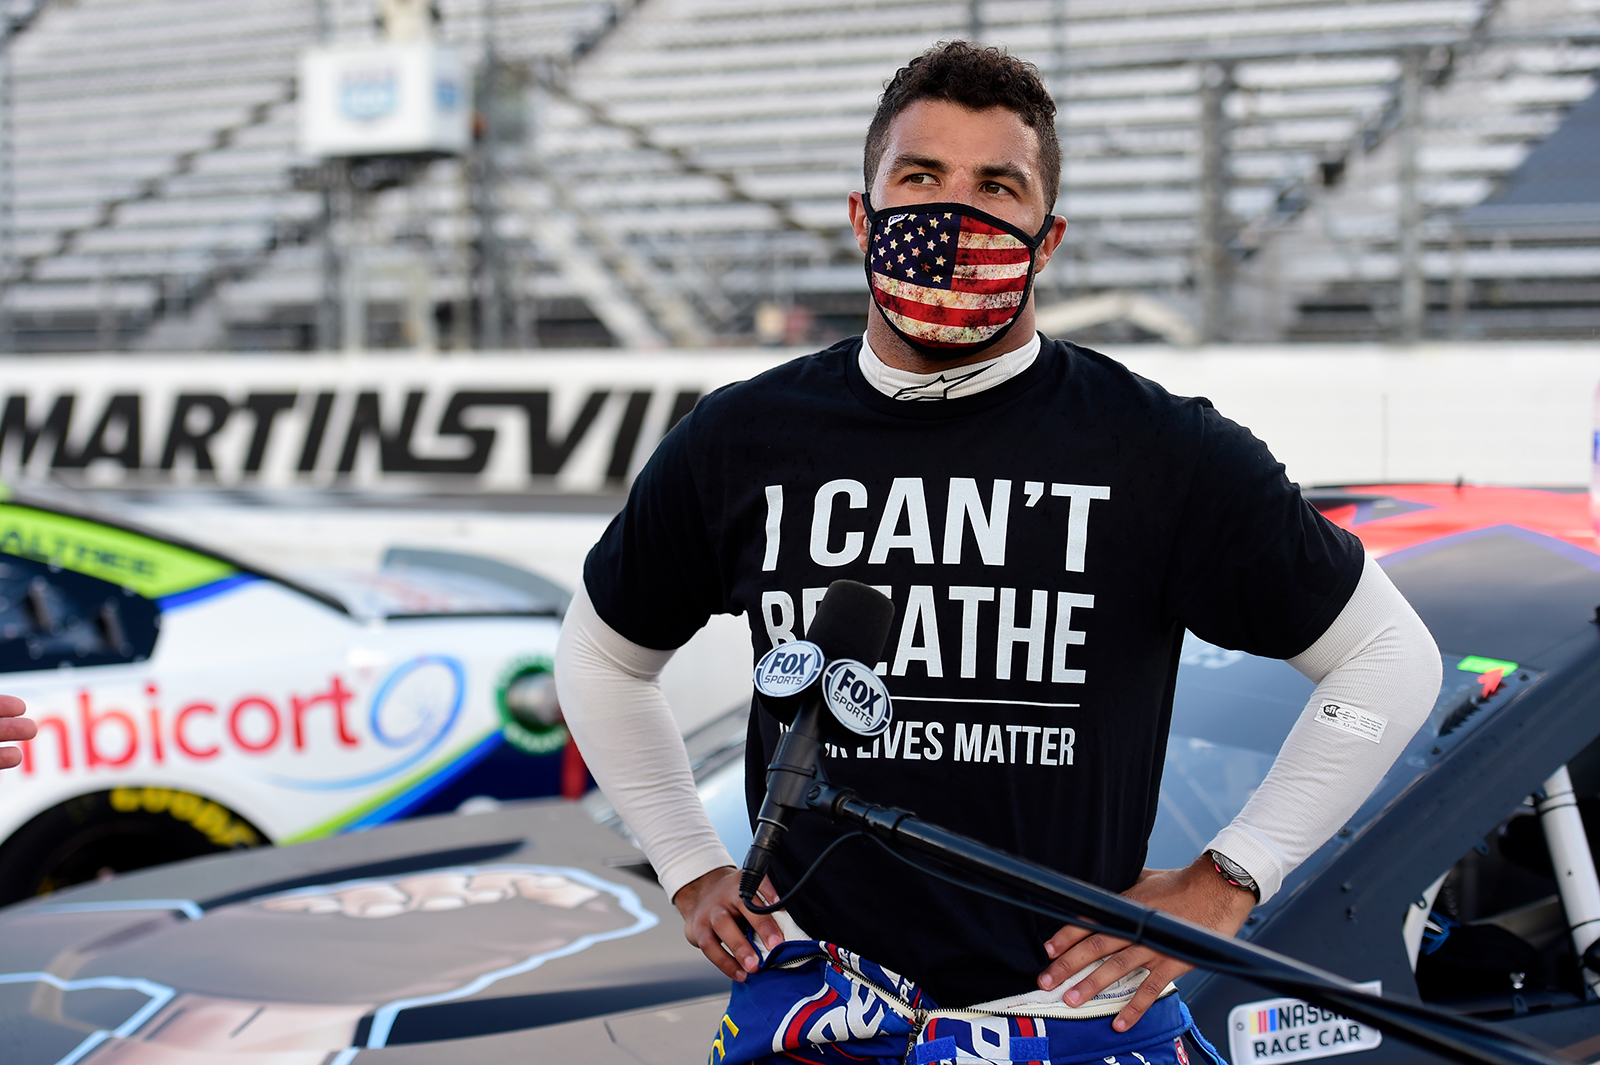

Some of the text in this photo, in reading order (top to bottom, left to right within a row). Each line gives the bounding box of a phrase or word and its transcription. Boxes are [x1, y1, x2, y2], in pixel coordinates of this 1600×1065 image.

[762, 477, 1111, 572] I CAN'T
[761, 585, 1095, 684] BATHE
[763, 674, 804, 686] SPORTS
[768, 652, 813, 676] FOX
[832, 691, 874, 727] SPORTS
[837, 668, 883, 718] FOX
[953, 722, 1076, 766] MATTER
[1278, 1002, 1351, 1031] NASC
[1254, 1025, 1361, 1059] RACE CAR
